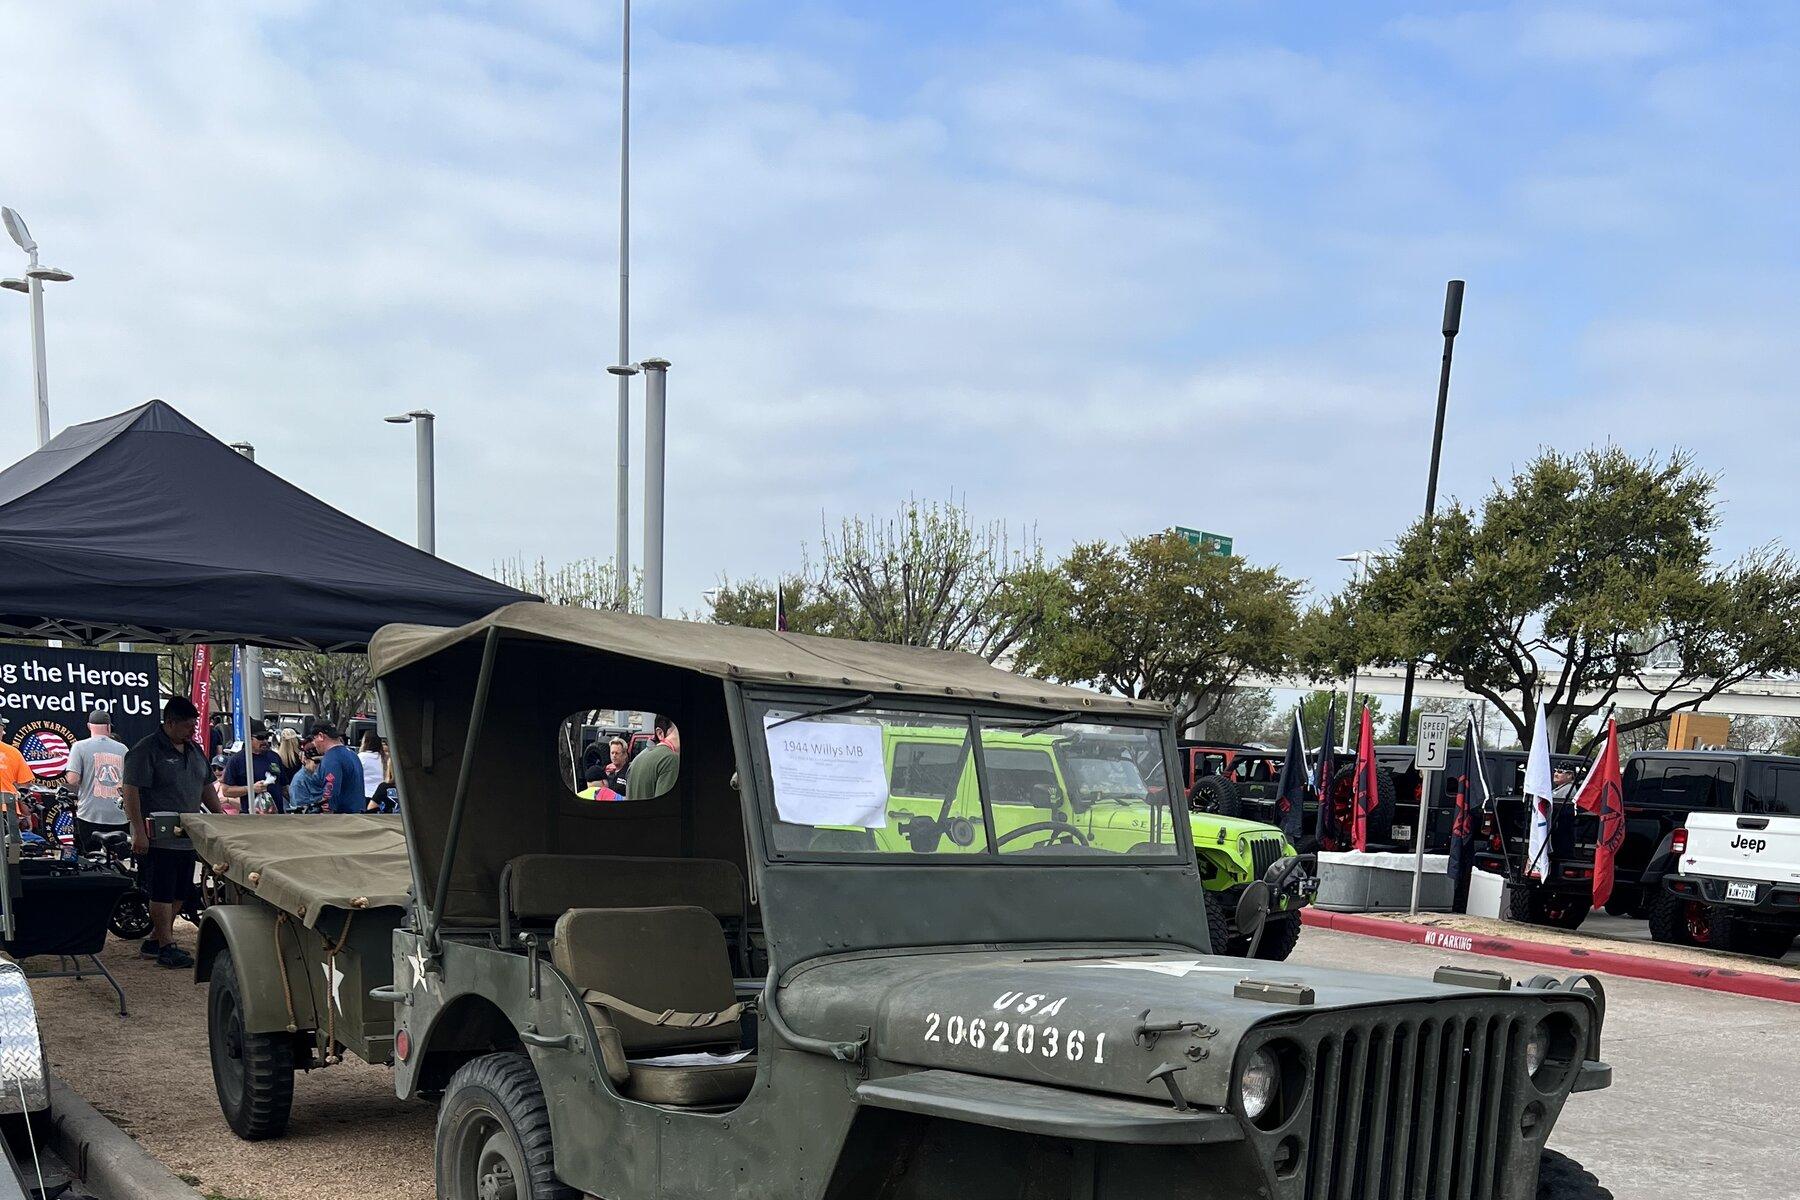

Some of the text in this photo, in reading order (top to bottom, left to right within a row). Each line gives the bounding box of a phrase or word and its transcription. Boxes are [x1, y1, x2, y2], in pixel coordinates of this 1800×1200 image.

[22, 660, 62, 683] the
[67, 663, 149, 688] Heroes
[80, 692, 117, 714] For
[122, 694, 152, 715] Us
[12, 720, 42, 748] MILITARY
[1422, 722, 1446, 731] SPEED
[1423, 731, 1443, 740] LIMIT
[783, 740, 863, 758] 1944 Willys MB
[1427, 742, 1436, 761] 5
[1730, 834, 1766, 853] Jeep
[1424, 931, 1473, 950] NO PARKING
[993, 991, 1067, 1017] USA
[924, 1012, 1106, 1064] 20620361
